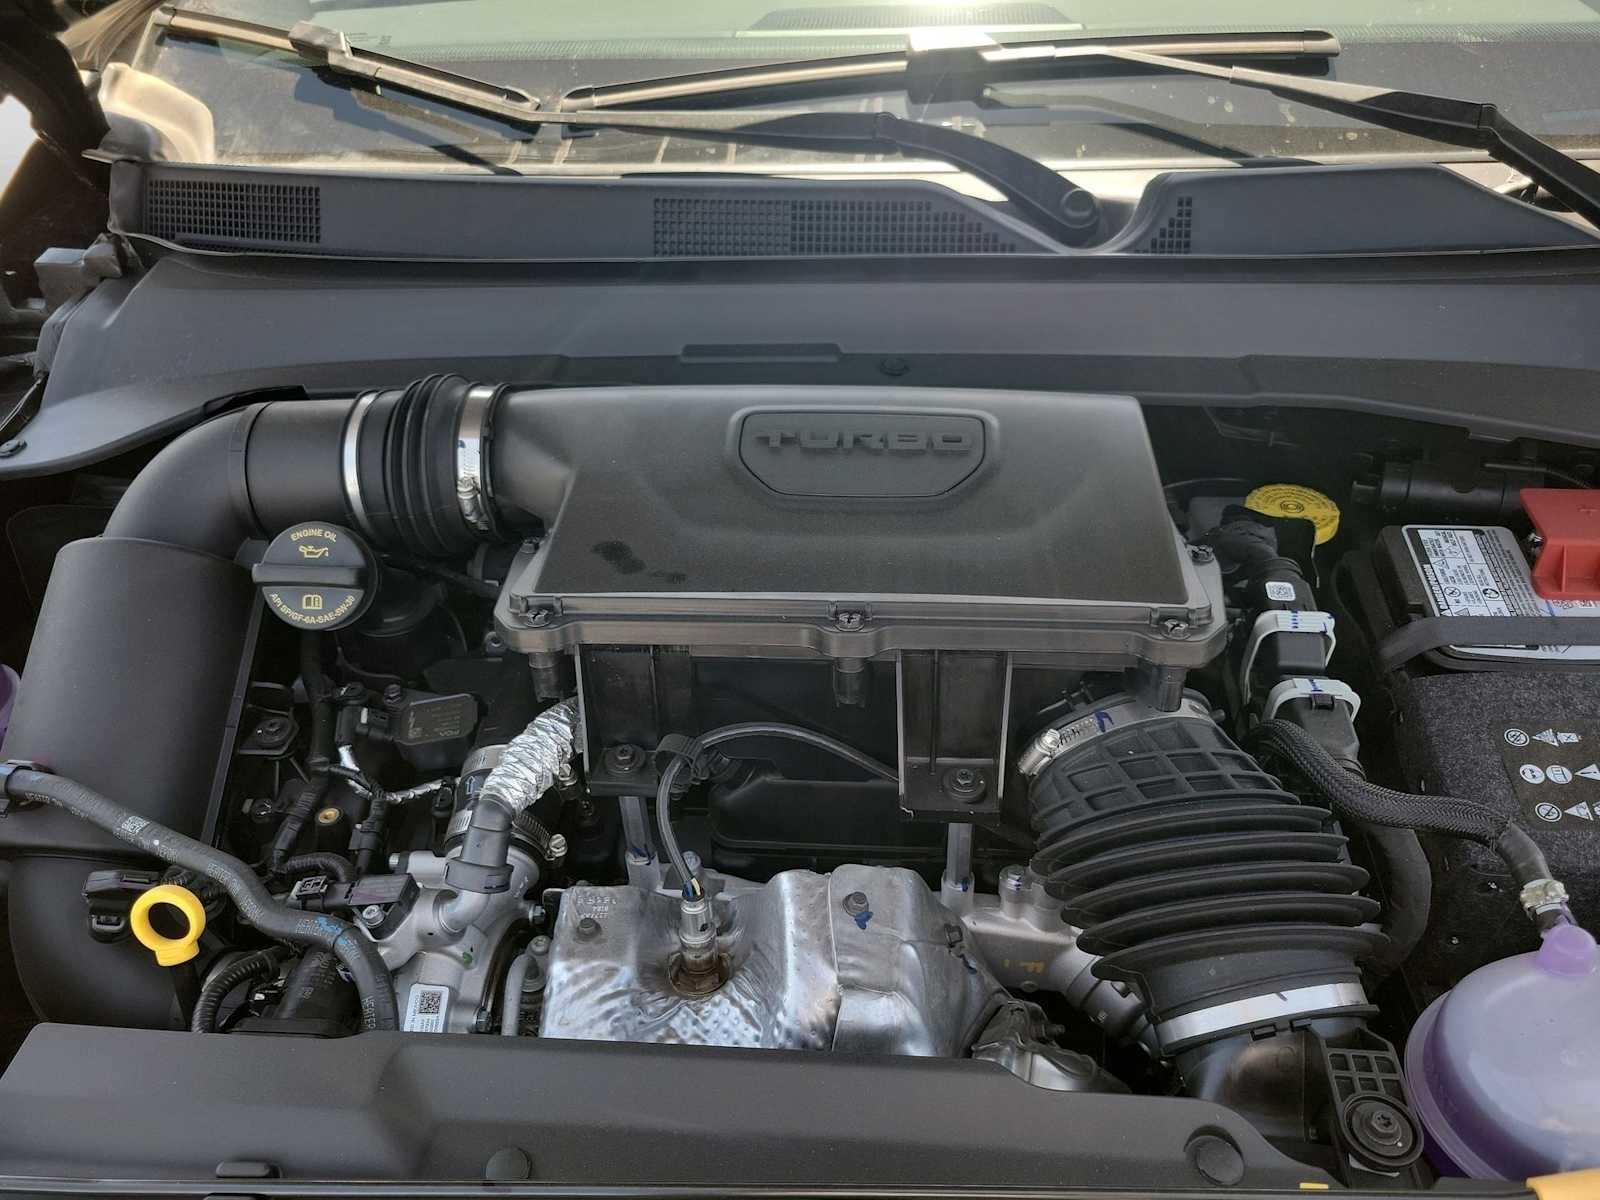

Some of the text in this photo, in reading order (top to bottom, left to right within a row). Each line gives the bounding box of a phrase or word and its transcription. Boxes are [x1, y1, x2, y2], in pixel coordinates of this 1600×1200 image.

[754, 431, 973, 453] TURBO
[291, 528, 337, 543] ENGINE OIL
[270, 593, 281, 607] API
